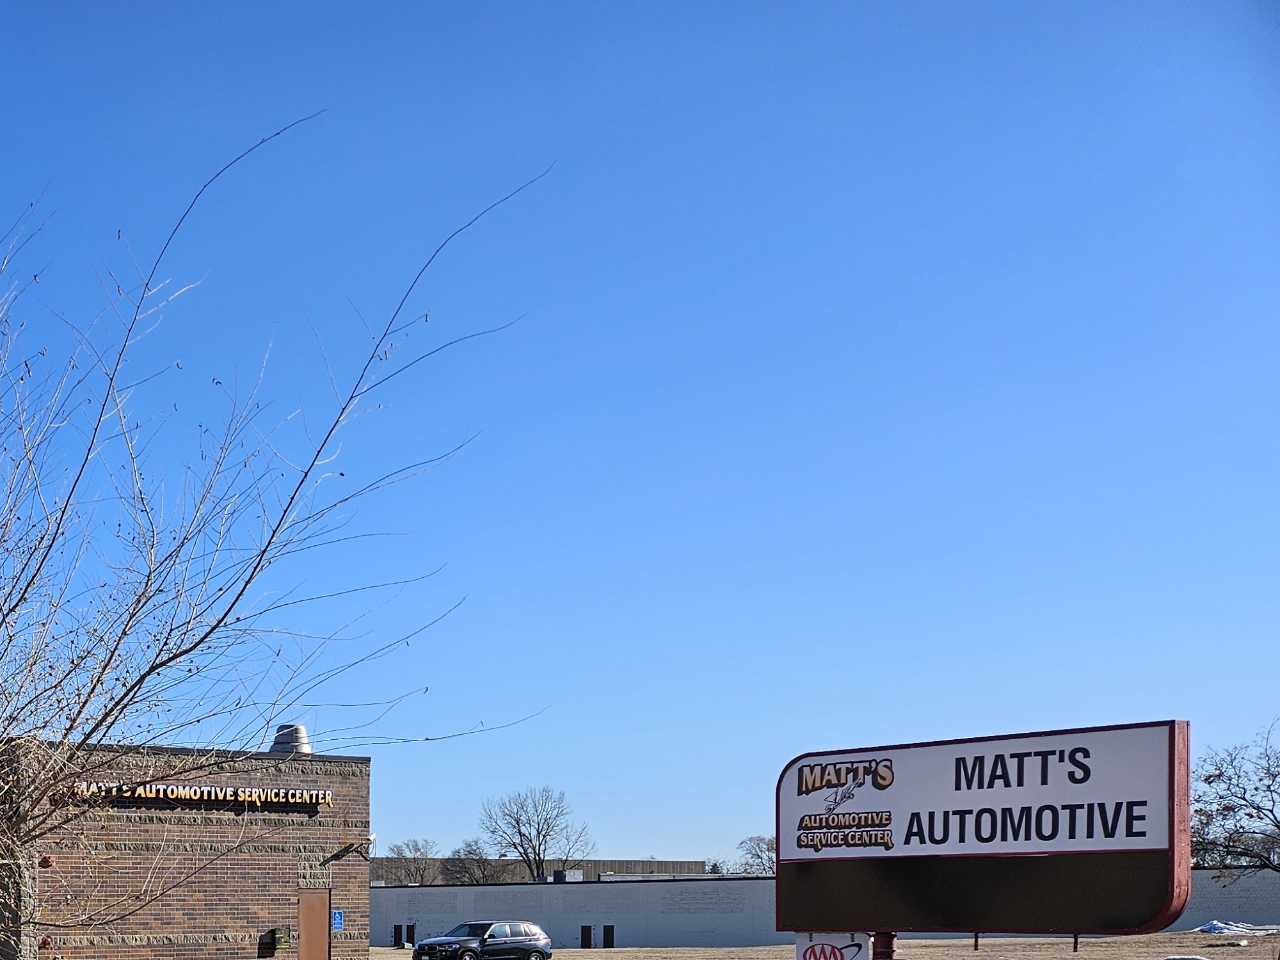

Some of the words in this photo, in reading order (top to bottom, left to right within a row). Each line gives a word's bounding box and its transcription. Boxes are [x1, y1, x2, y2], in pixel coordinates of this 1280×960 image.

[800, 759, 893, 794] MATT'S
[954, 747, 1091, 791] MATT'S
[135, 783, 235, 800] AUTOMOTIVE
[237, 787, 286, 806] SERVICE
[288, 789, 334, 808] CENTER
[800, 812, 891, 828] AUTOMOTIVE
[903, 801, 1148, 846] AUTOMOTIVE
[800, 831, 846, 850] SERVICE
[847, 830, 893, 848] CENTER
